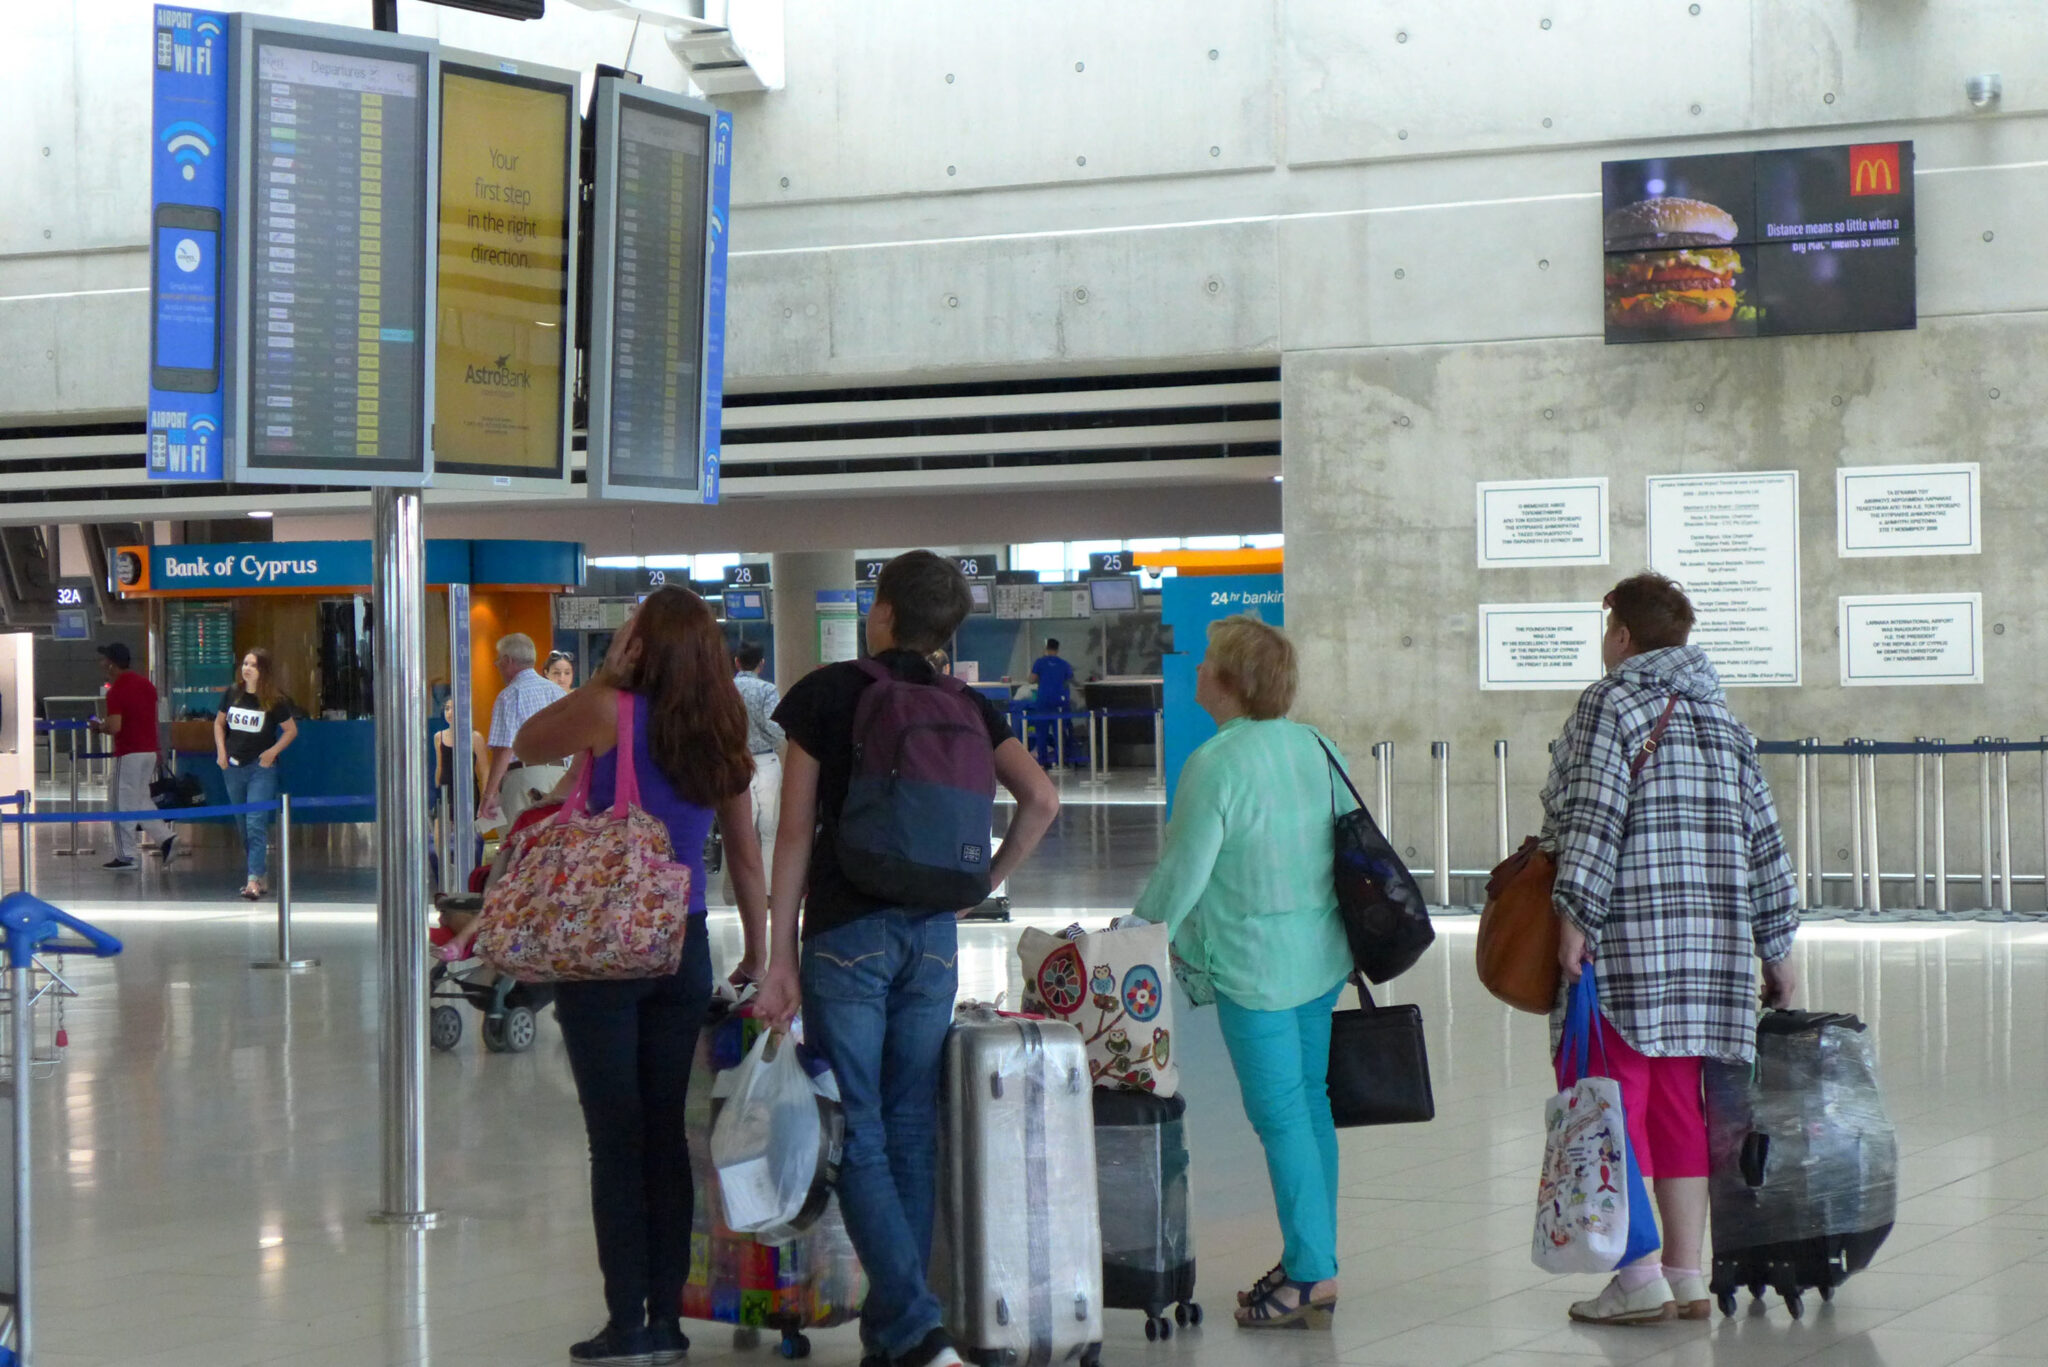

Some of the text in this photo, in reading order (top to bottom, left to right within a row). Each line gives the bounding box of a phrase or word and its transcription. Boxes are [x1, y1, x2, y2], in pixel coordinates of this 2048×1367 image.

[157, 9, 192, 28] AIRPORT
[311, 59, 367, 80] Departures
[490, 147, 520, 171] Your
[475, 177, 531, 210] first step
[467, 208, 537, 243] in the right
[1767, 217, 1900, 237] Distance means so little when a
[1860, 238, 1872, 248] so
[471, 242, 531, 270] direction.
[464, 364, 531, 389] AstroBank
[151, 410, 187, 429] AIRPORT
[165, 554, 318, 582] Bank of Cyprus
[866, 562, 884, 578] 27
[960, 558, 978, 576] 26
[1102, 554, 1122, 572] 25
[649, 570, 665, 585] 29
[734, 567, 752, 583] 28
[57, 589, 82, 604] 32A
[1211, 589, 1284, 606] 24 hr bankin
[228, 706, 260, 727] MSGM
